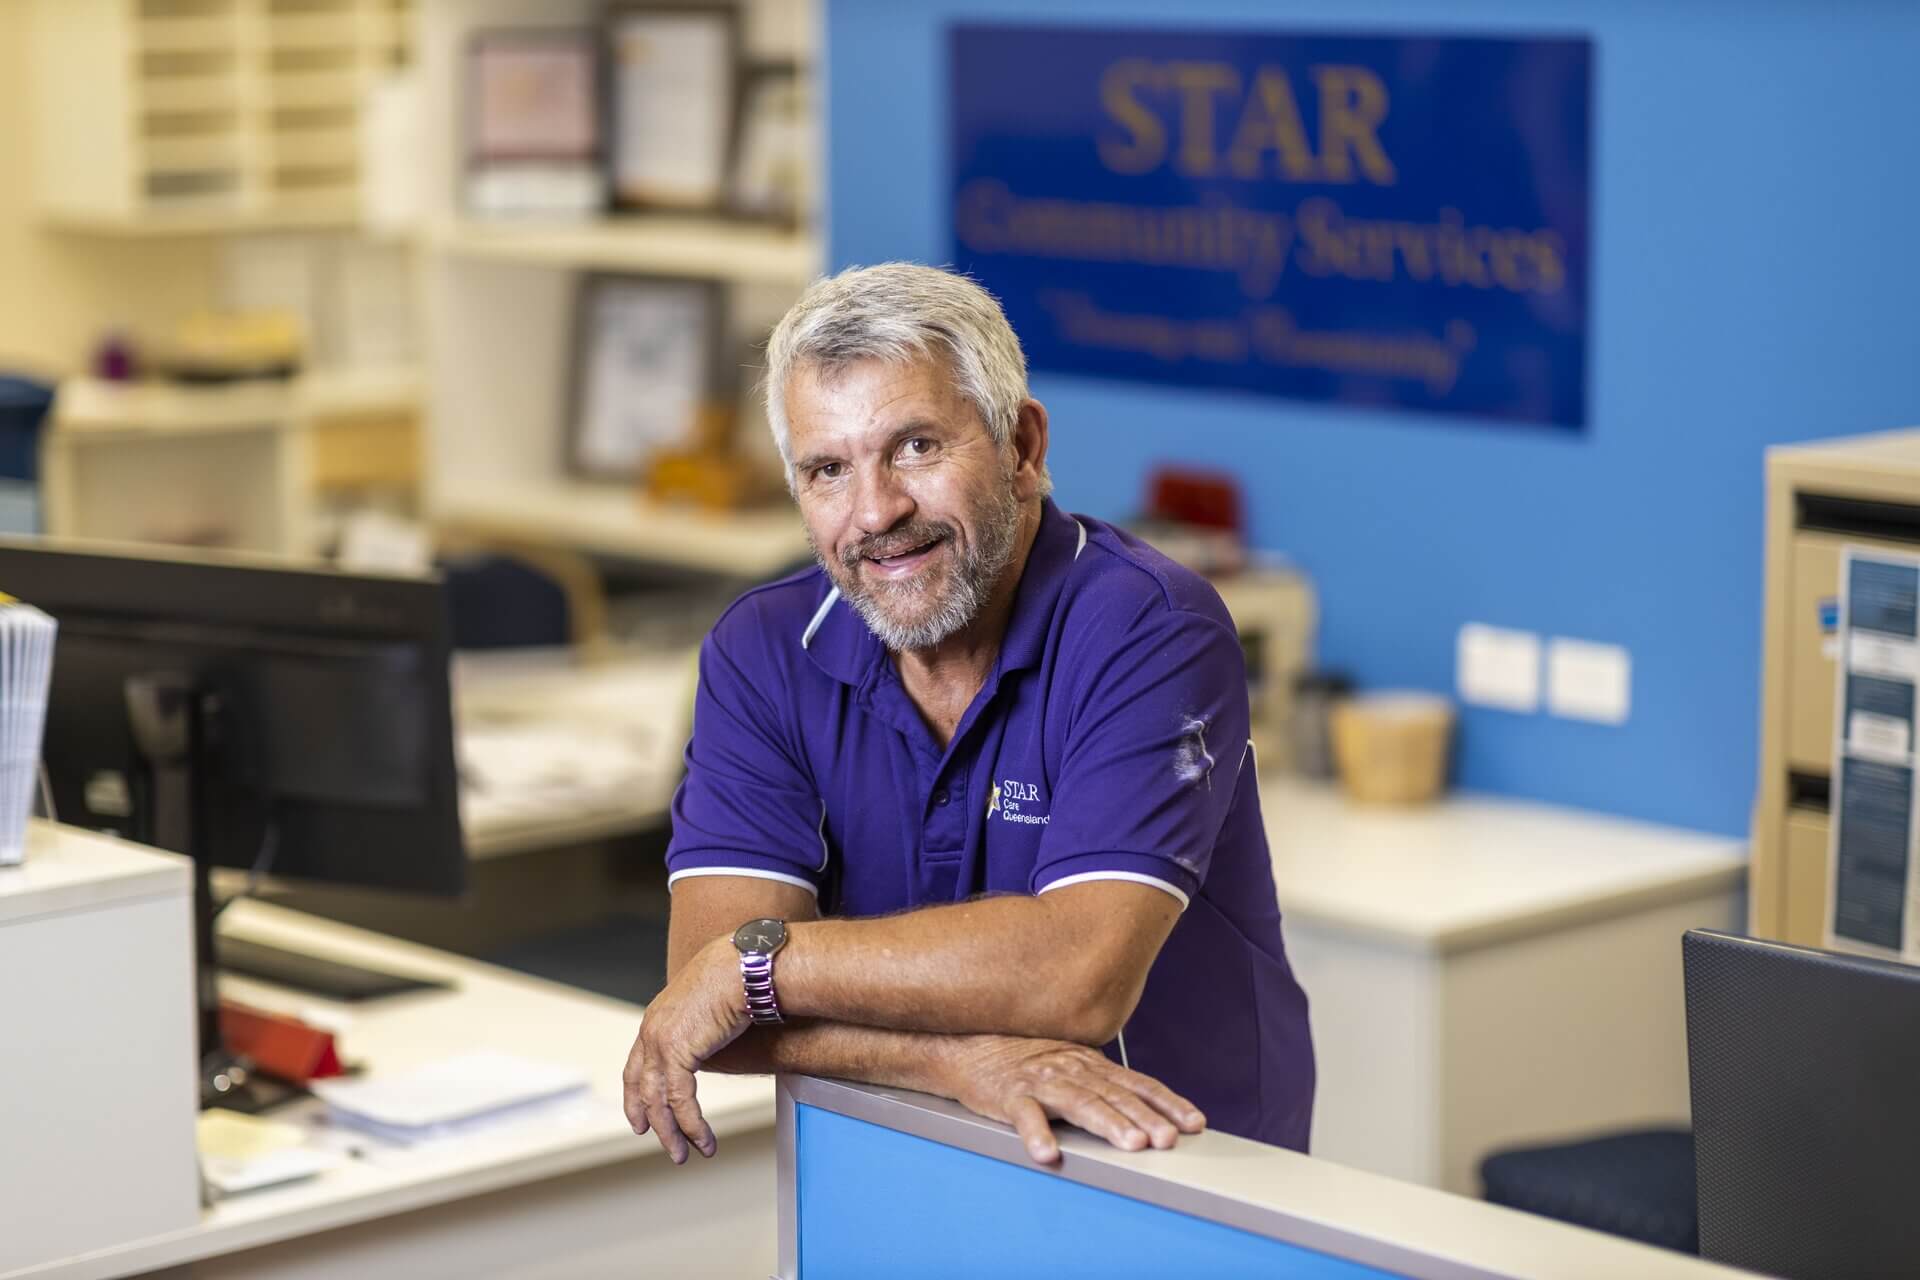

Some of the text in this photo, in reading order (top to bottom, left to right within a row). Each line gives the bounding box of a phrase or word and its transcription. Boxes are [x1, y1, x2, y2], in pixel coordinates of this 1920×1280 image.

[1100, 59, 1395, 185] STAR
[957, 179, 1564, 299] Community Services
[1003, 779, 1040, 802] STAR
[1003, 798, 1020, 811] Care
[1002, 810, 1050, 824] Queensland
